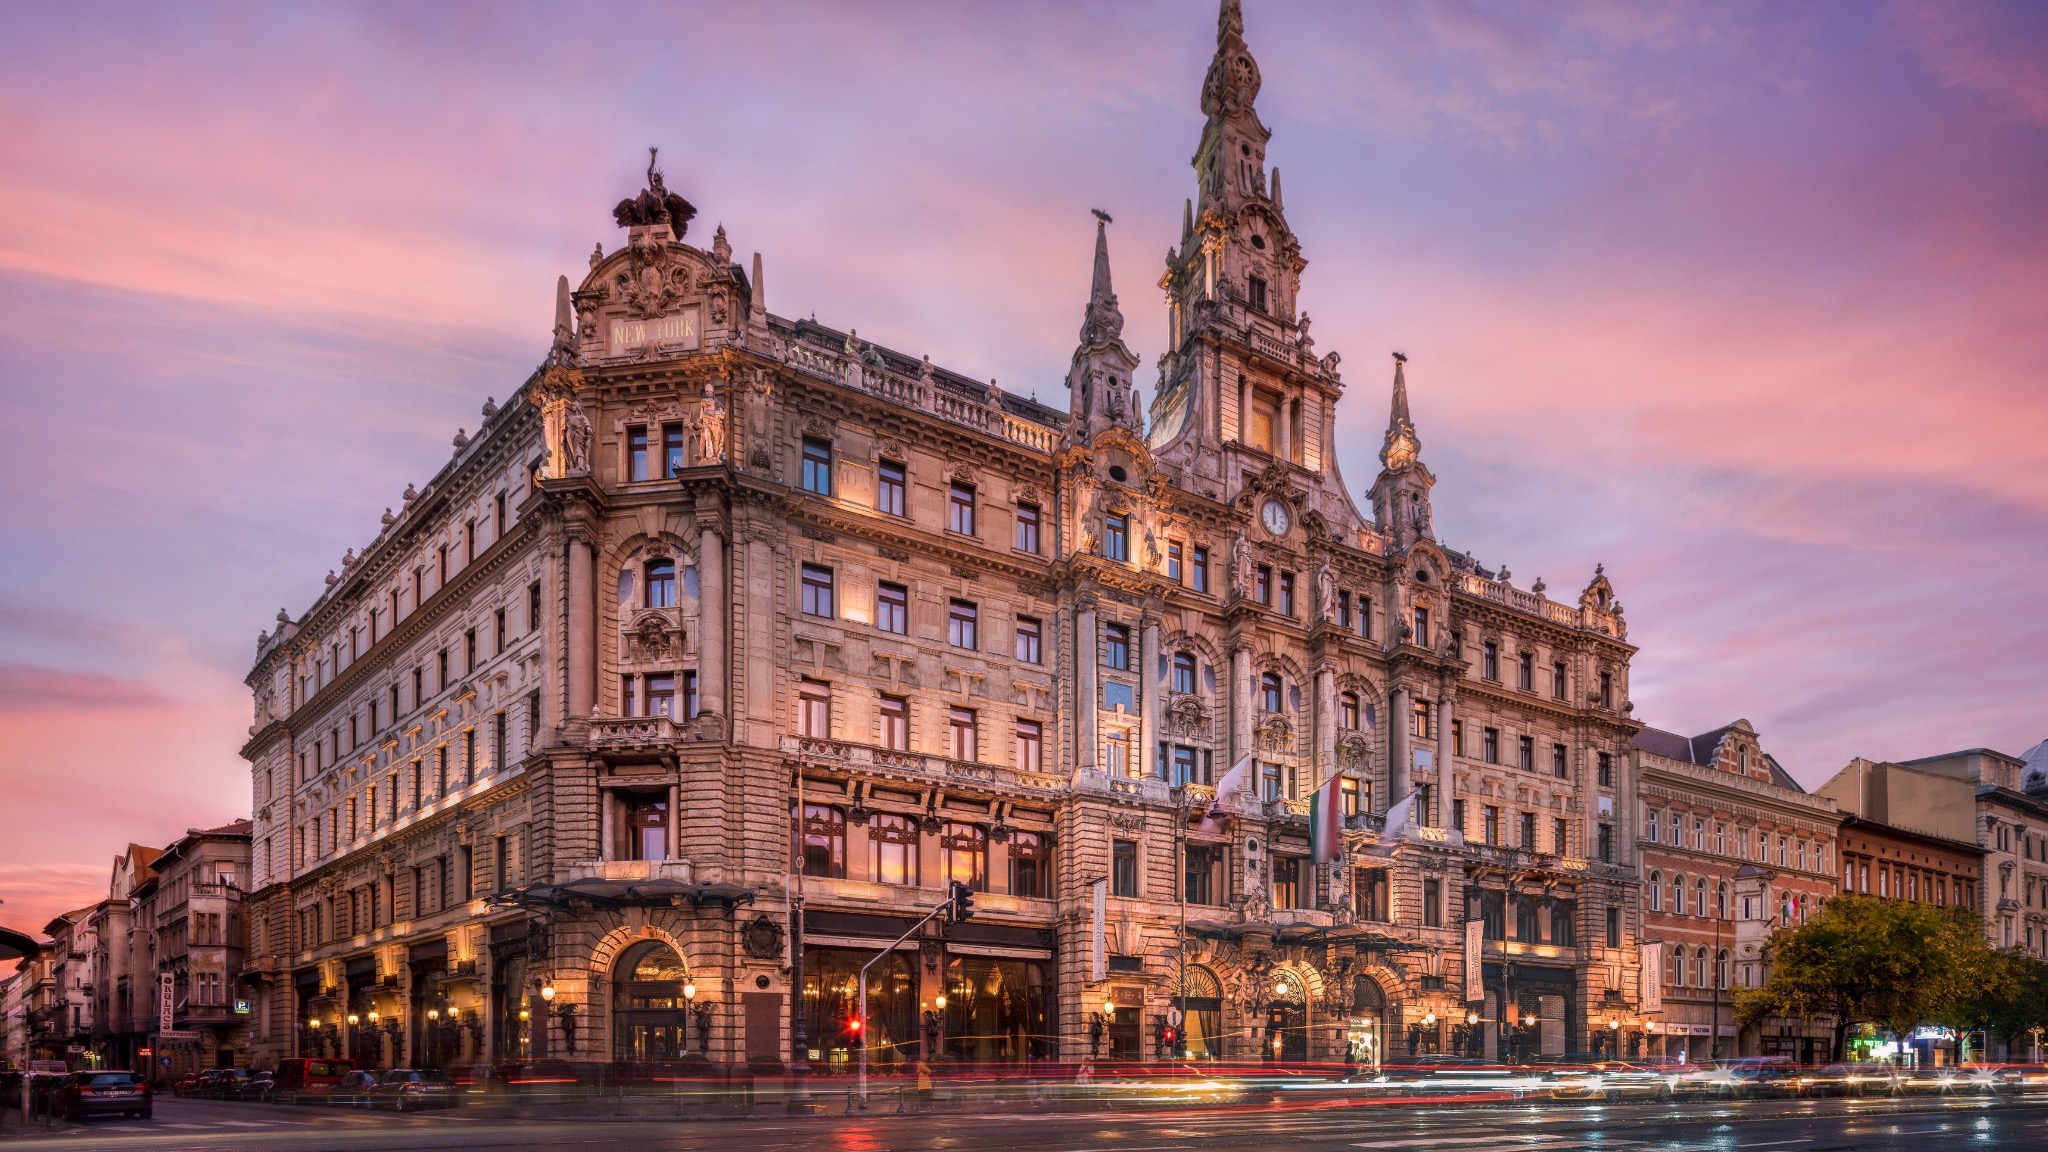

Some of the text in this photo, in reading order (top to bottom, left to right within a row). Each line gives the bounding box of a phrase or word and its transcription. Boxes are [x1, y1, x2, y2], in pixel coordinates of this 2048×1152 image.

[614, 319, 695, 345] NEW YORK
[163, 985, 171, 1030] KULACS
[238, 1001, 246, 1009] P
